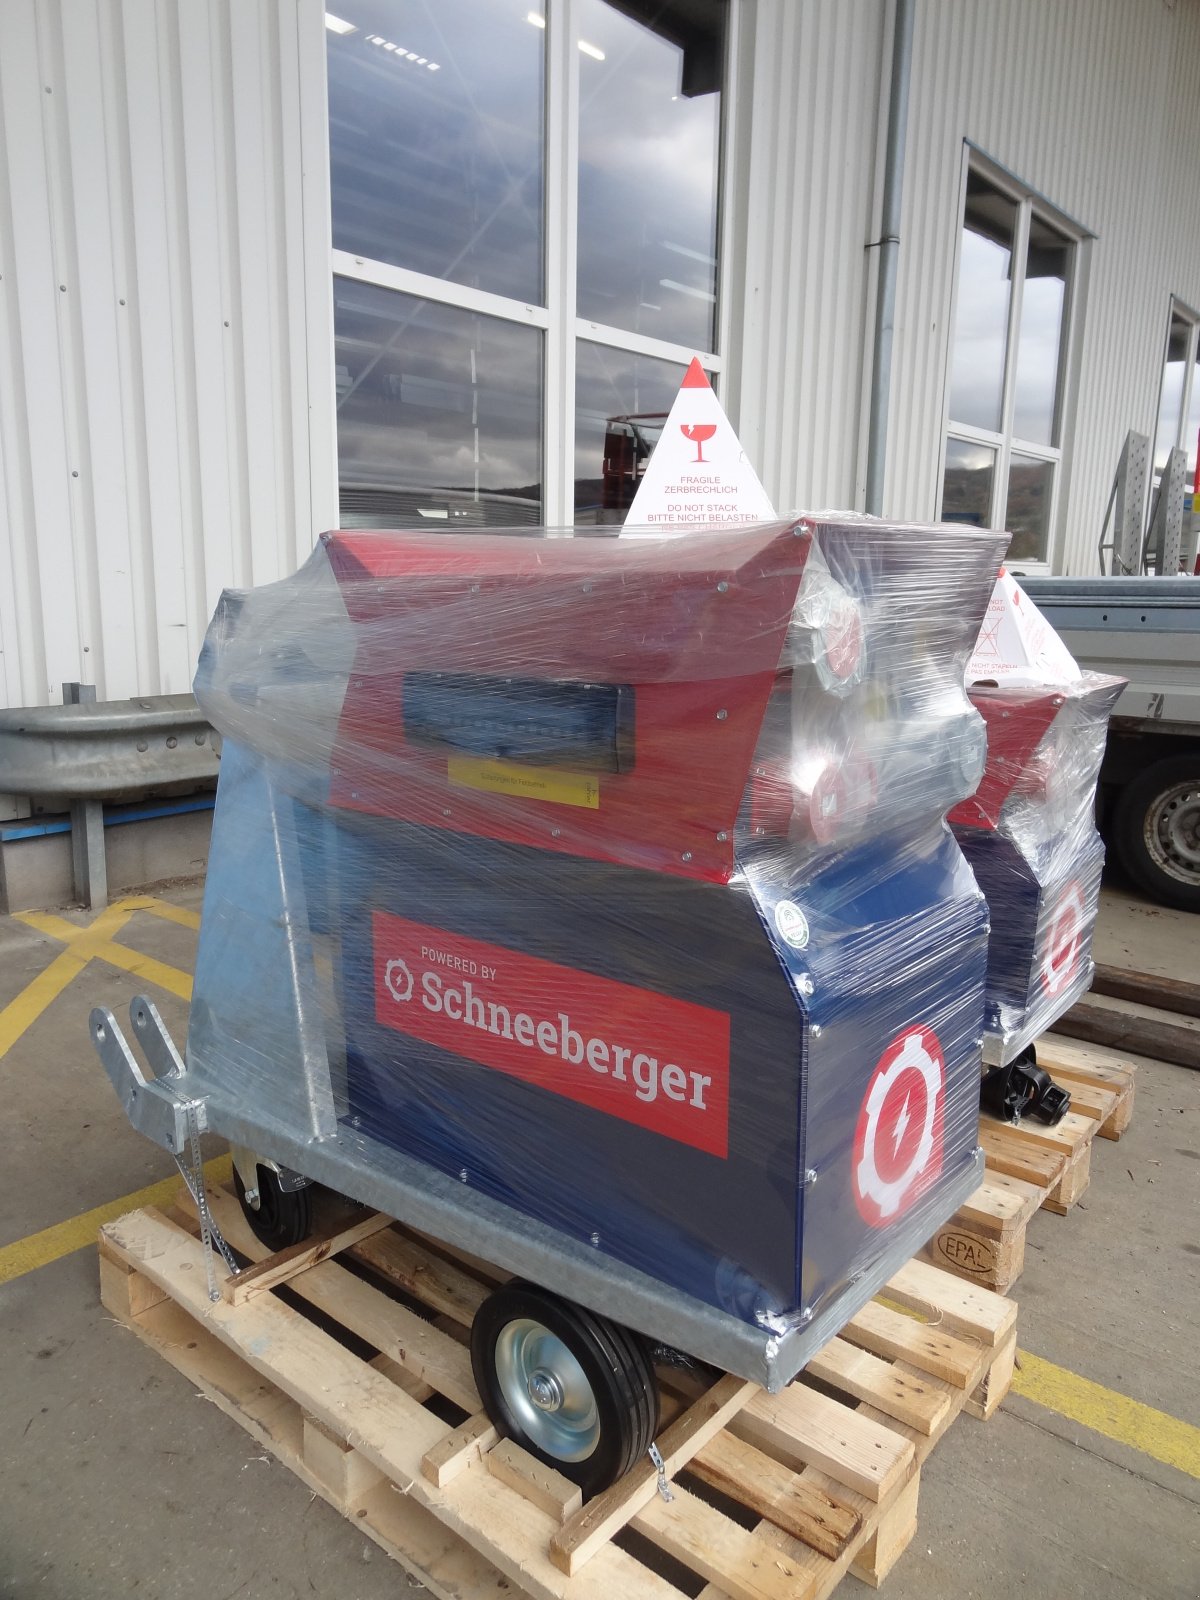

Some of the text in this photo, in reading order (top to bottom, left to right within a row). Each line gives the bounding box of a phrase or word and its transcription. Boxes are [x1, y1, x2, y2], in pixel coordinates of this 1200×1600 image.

[680, 476, 721, 484] FRAGILE
[664, 486, 738, 494] ZERBRECHLICH
[667, 504, 738, 512] DO NOT STACK
[647, 513, 758, 522] BITTE NICHT BELASTEN
[421, 946, 497, 981] POWERED BY
[421, 971, 712, 1110] Schneeberger
